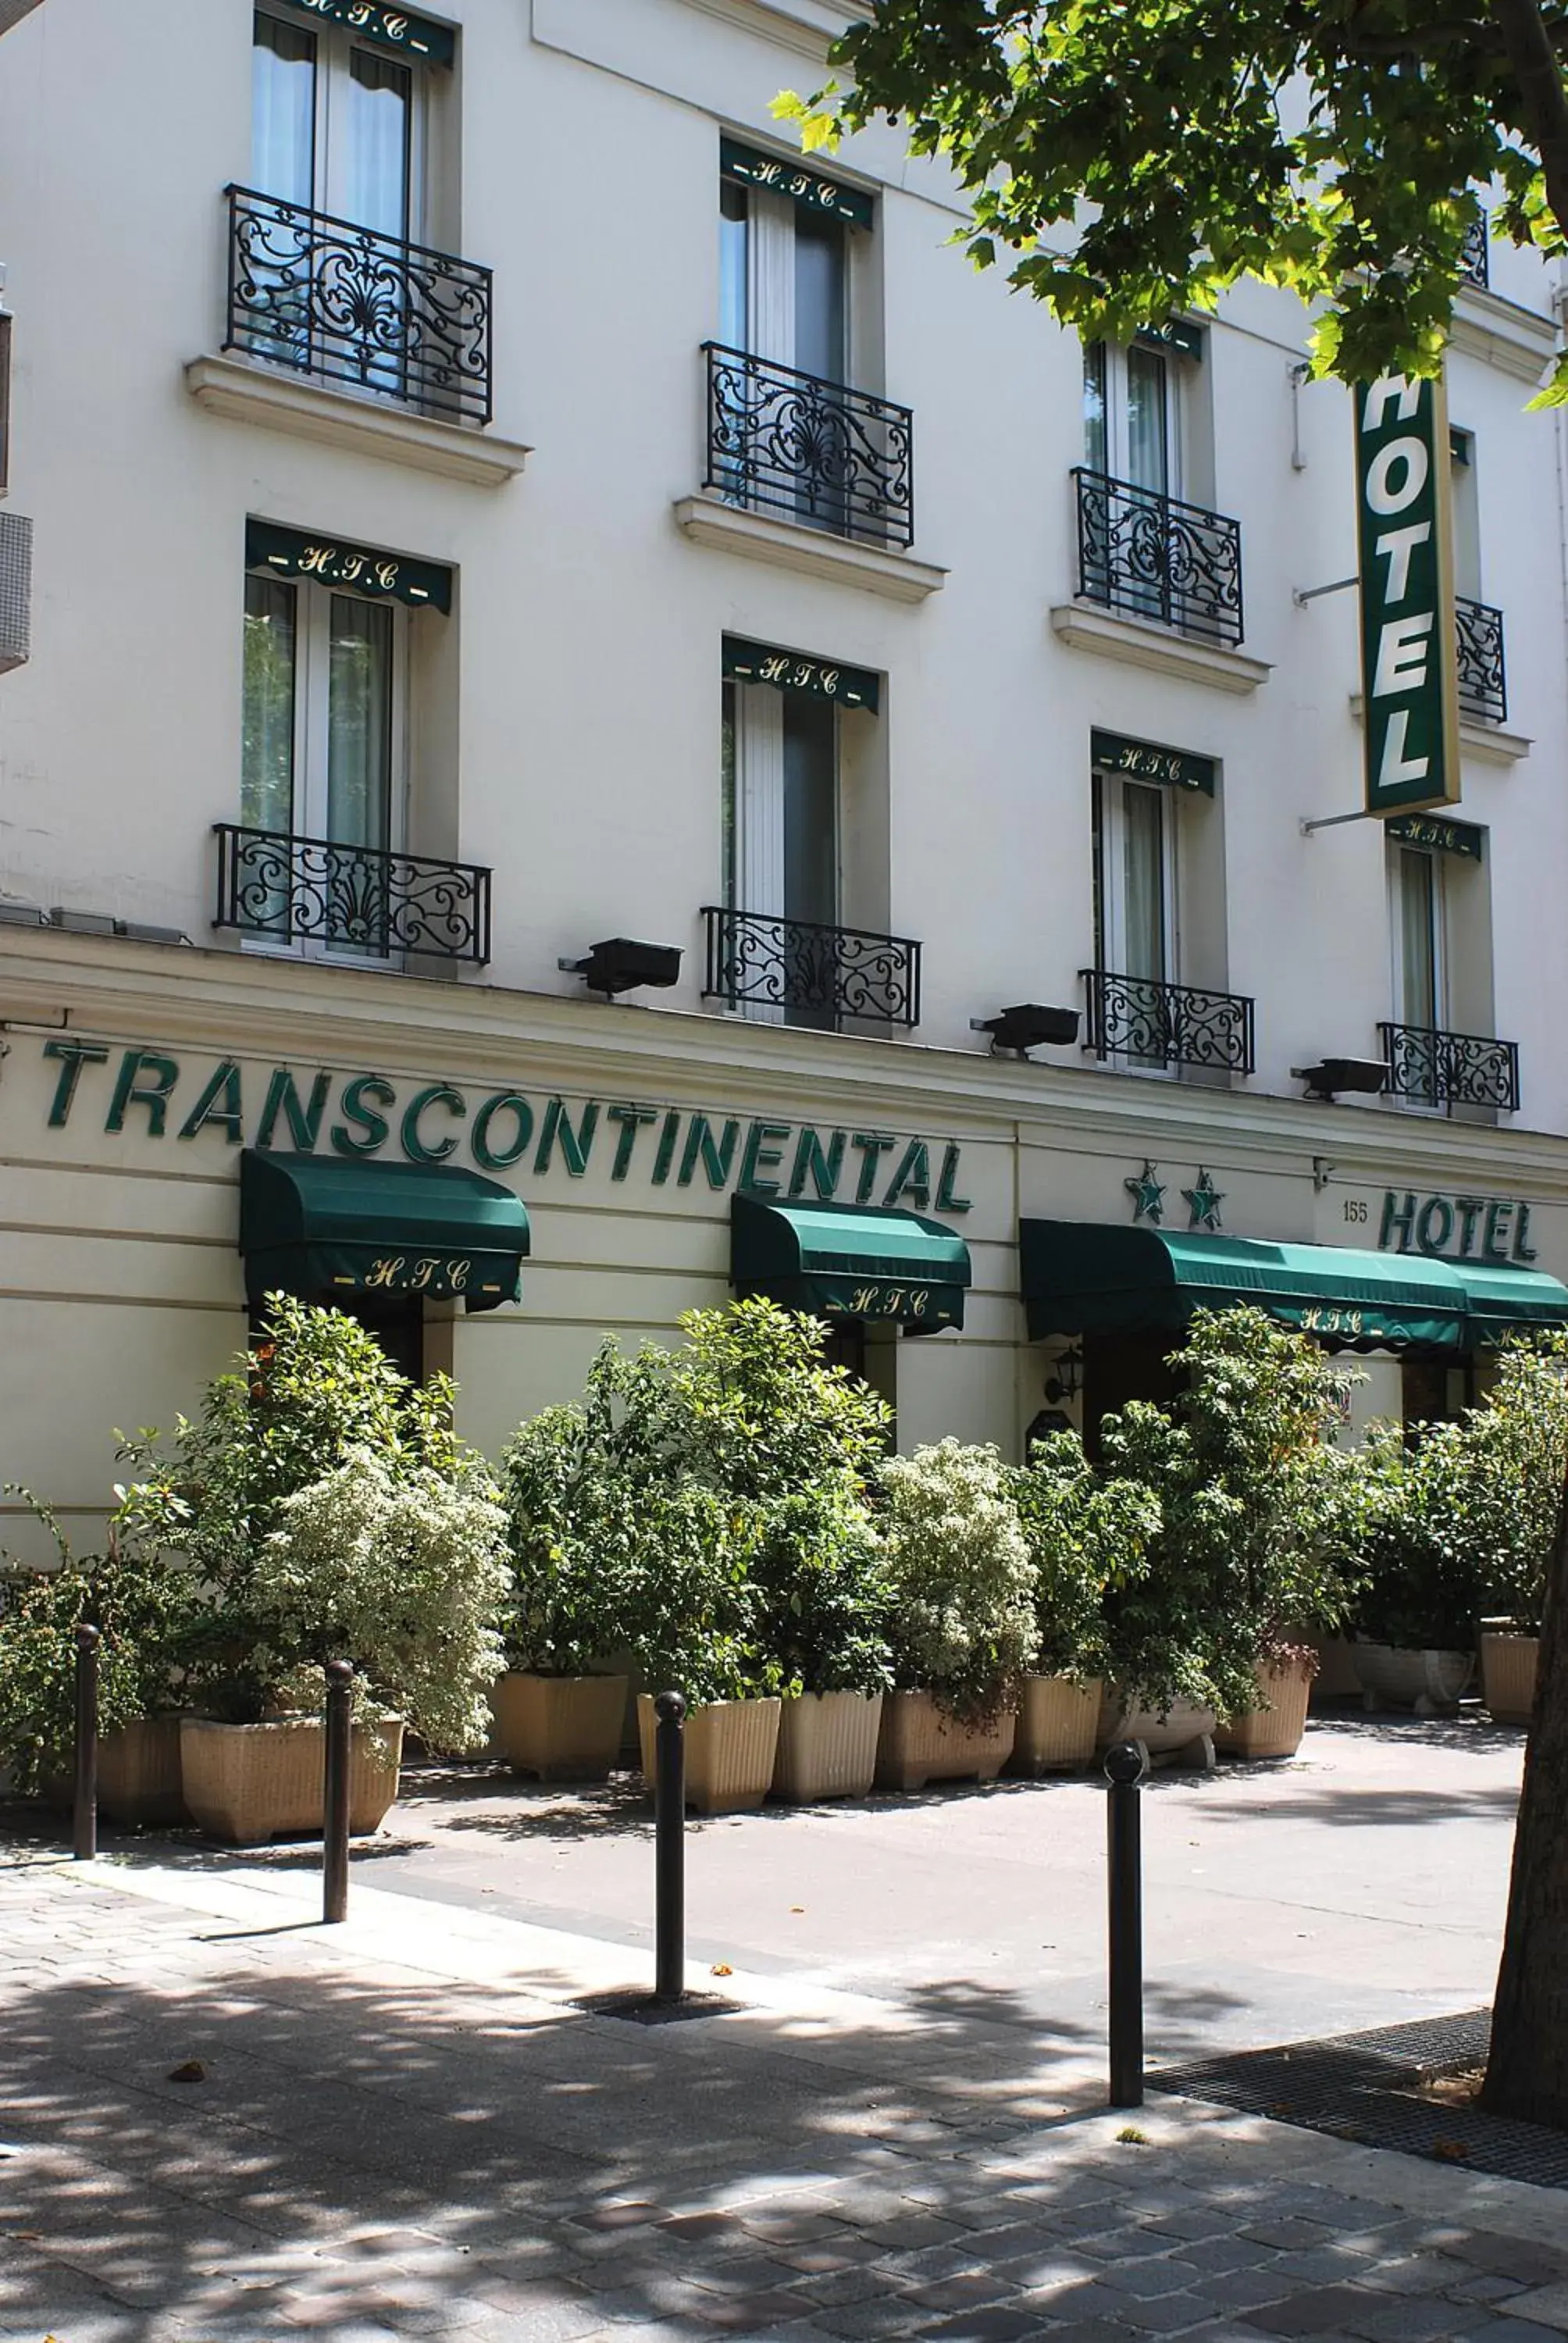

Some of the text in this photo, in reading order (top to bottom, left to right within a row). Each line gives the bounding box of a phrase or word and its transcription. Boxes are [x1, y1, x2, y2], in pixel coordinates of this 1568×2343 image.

[752, 161, 838, 207] H.T.C
[298, 547, 399, 589] H.T.C
[759, 656, 839, 694] H.T.C
[1119, 749, 1181, 780] H.T.C
[42, 1039, 975, 1212] TRANSCONTINENTAL
[1343, 1200, 1368, 1224] 155
[1377, 1191, 1540, 1261] HOTEL
[365, 1257, 471, 1289] H.T.C
[849, 1286, 928, 1317] H.T.C
[1299, 1306, 1361, 1333] H.T.C
